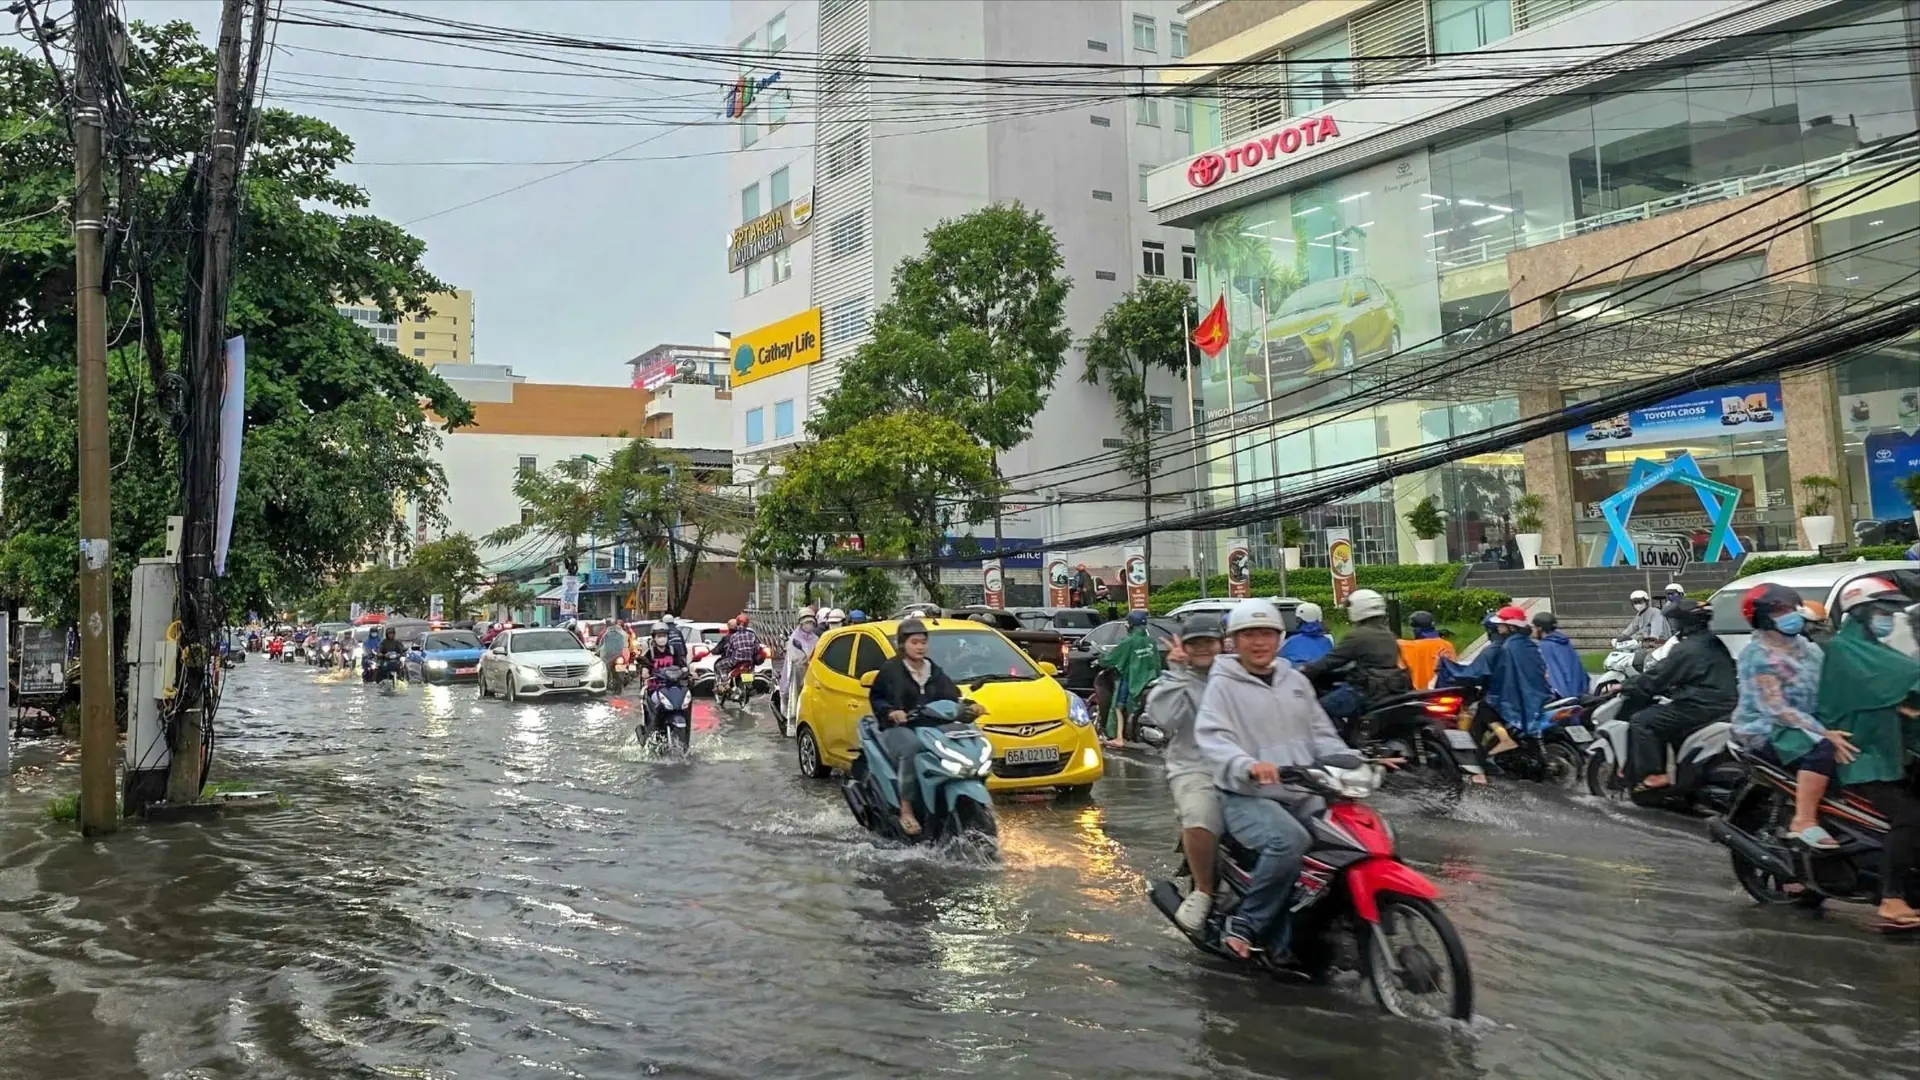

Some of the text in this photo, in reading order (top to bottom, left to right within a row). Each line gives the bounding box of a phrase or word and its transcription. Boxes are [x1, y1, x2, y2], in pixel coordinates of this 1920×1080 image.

[1225, 115, 1341, 173] TOYOTA
[734, 226, 751, 250] FPT
[751, 210, 784, 242] ARENA
[734, 228, 785, 266] MULTIMEDIA
[758, 330, 815, 365] Cathay Life
[1644, 410, 1677, 421] TOYOTA
[1677, 406, 1706, 417] CROSS
[1640, 545, 1680, 567] LỐI VÀO
